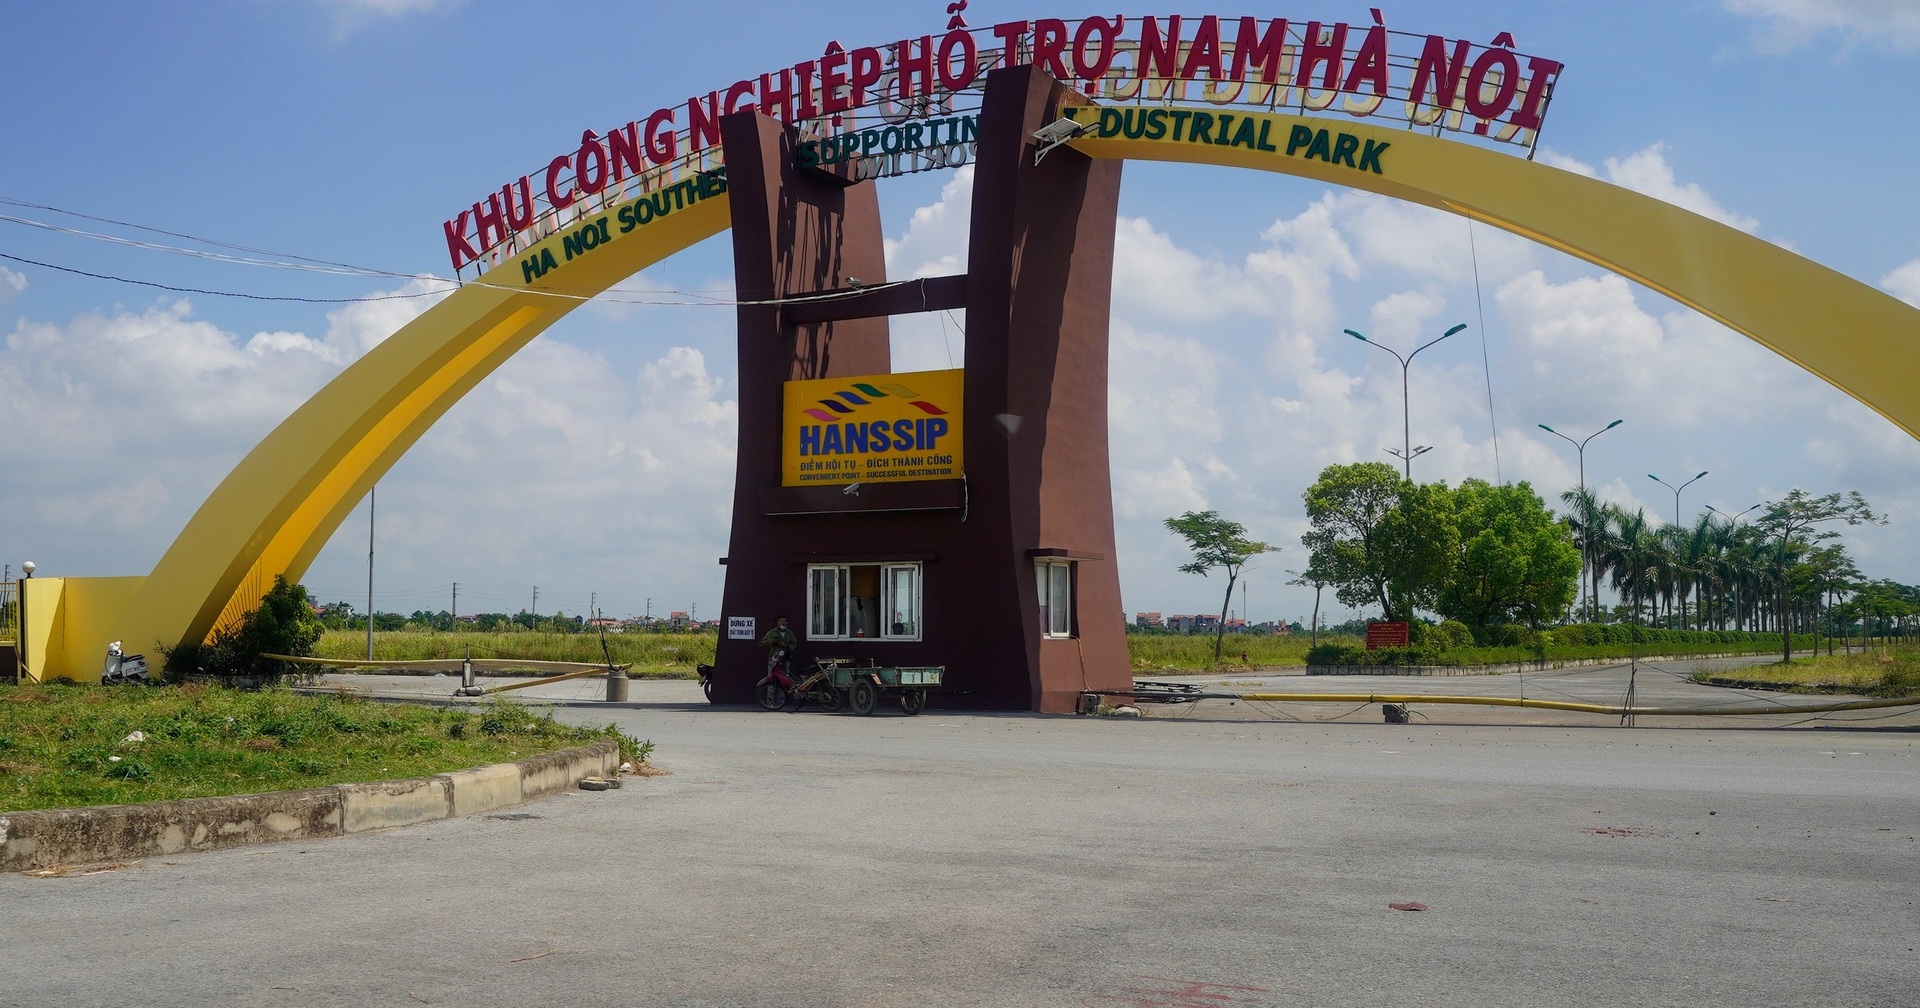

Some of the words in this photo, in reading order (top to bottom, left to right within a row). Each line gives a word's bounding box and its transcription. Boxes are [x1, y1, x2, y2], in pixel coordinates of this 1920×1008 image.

[443, 175, 533, 269] KHU
[546, 108, 678, 210] CÔNG
[688, 40, 883, 152] NGHIỆP
[899, 0, 978, 99] HỖ
[994, 14, 1125, 95] TRỢ
[1137, 14, 1289, 84] NAM
[1296, 7, 1388, 96] HÀ
[1409, 31, 1562, 136] NỘI
[521, 248, 558, 283] HA
[563, 217, 611, 261] NOI
[617, 166, 728, 233] SOUTHE
[800, 114, 981, 168] SUPPORTIN
[1063, 107, 1276, 153] DUSTRIAL
[1286, 124, 1391, 174] PARK
[800, 418, 948, 456] HANSSIP
[800, 458, 823, 471] ĐIỂM
[825, 459, 841, 471] HỘI
[843, 460, 856, 471] TỤ
[866, 456, 889, 468] ĐÍCH
[892, 455, 923, 467] THÀNH
[927, 454, 952, 465] CÔNG
[866, 470, 907, 478] SUCCESSFUL
[909, 468, 952, 476] DESTINATION
